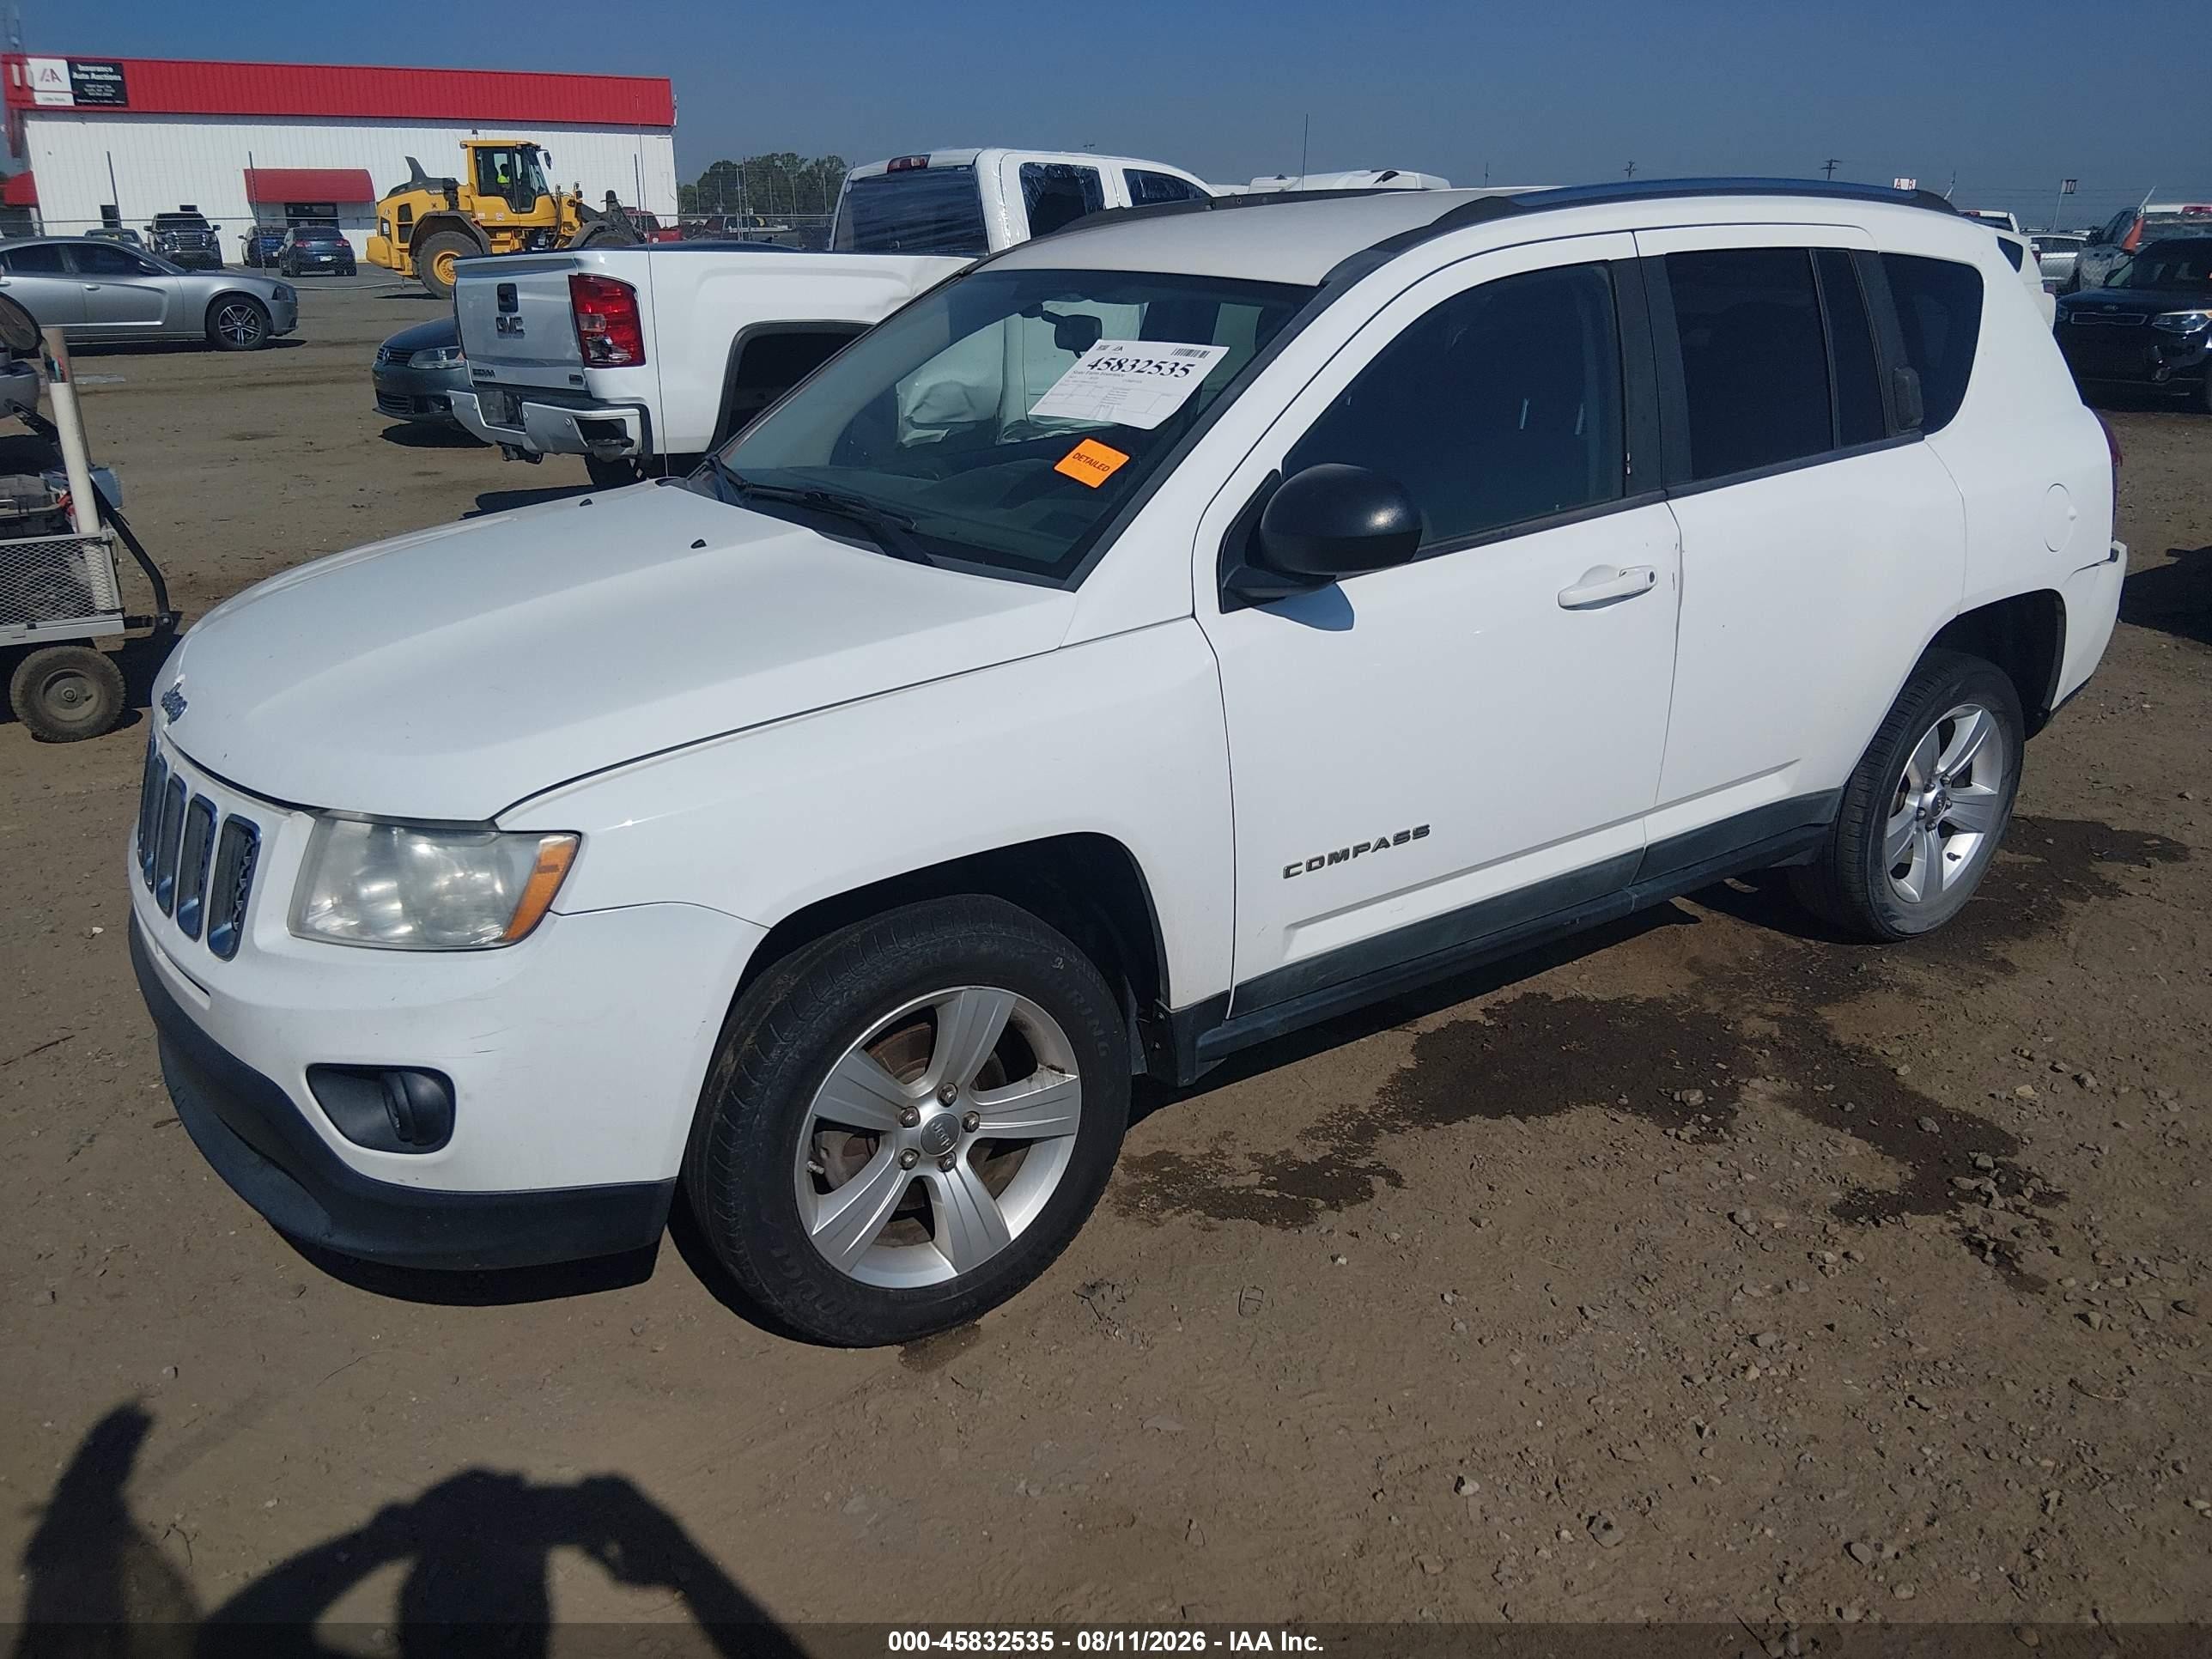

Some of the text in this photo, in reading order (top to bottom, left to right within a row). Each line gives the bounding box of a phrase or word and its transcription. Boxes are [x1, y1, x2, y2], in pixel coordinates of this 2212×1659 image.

[1087, 356, 1196, 378] 45832535
[1072, 452, 1110, 473] DETAILED
[1283, 823, 1431, 879] COMPASS
